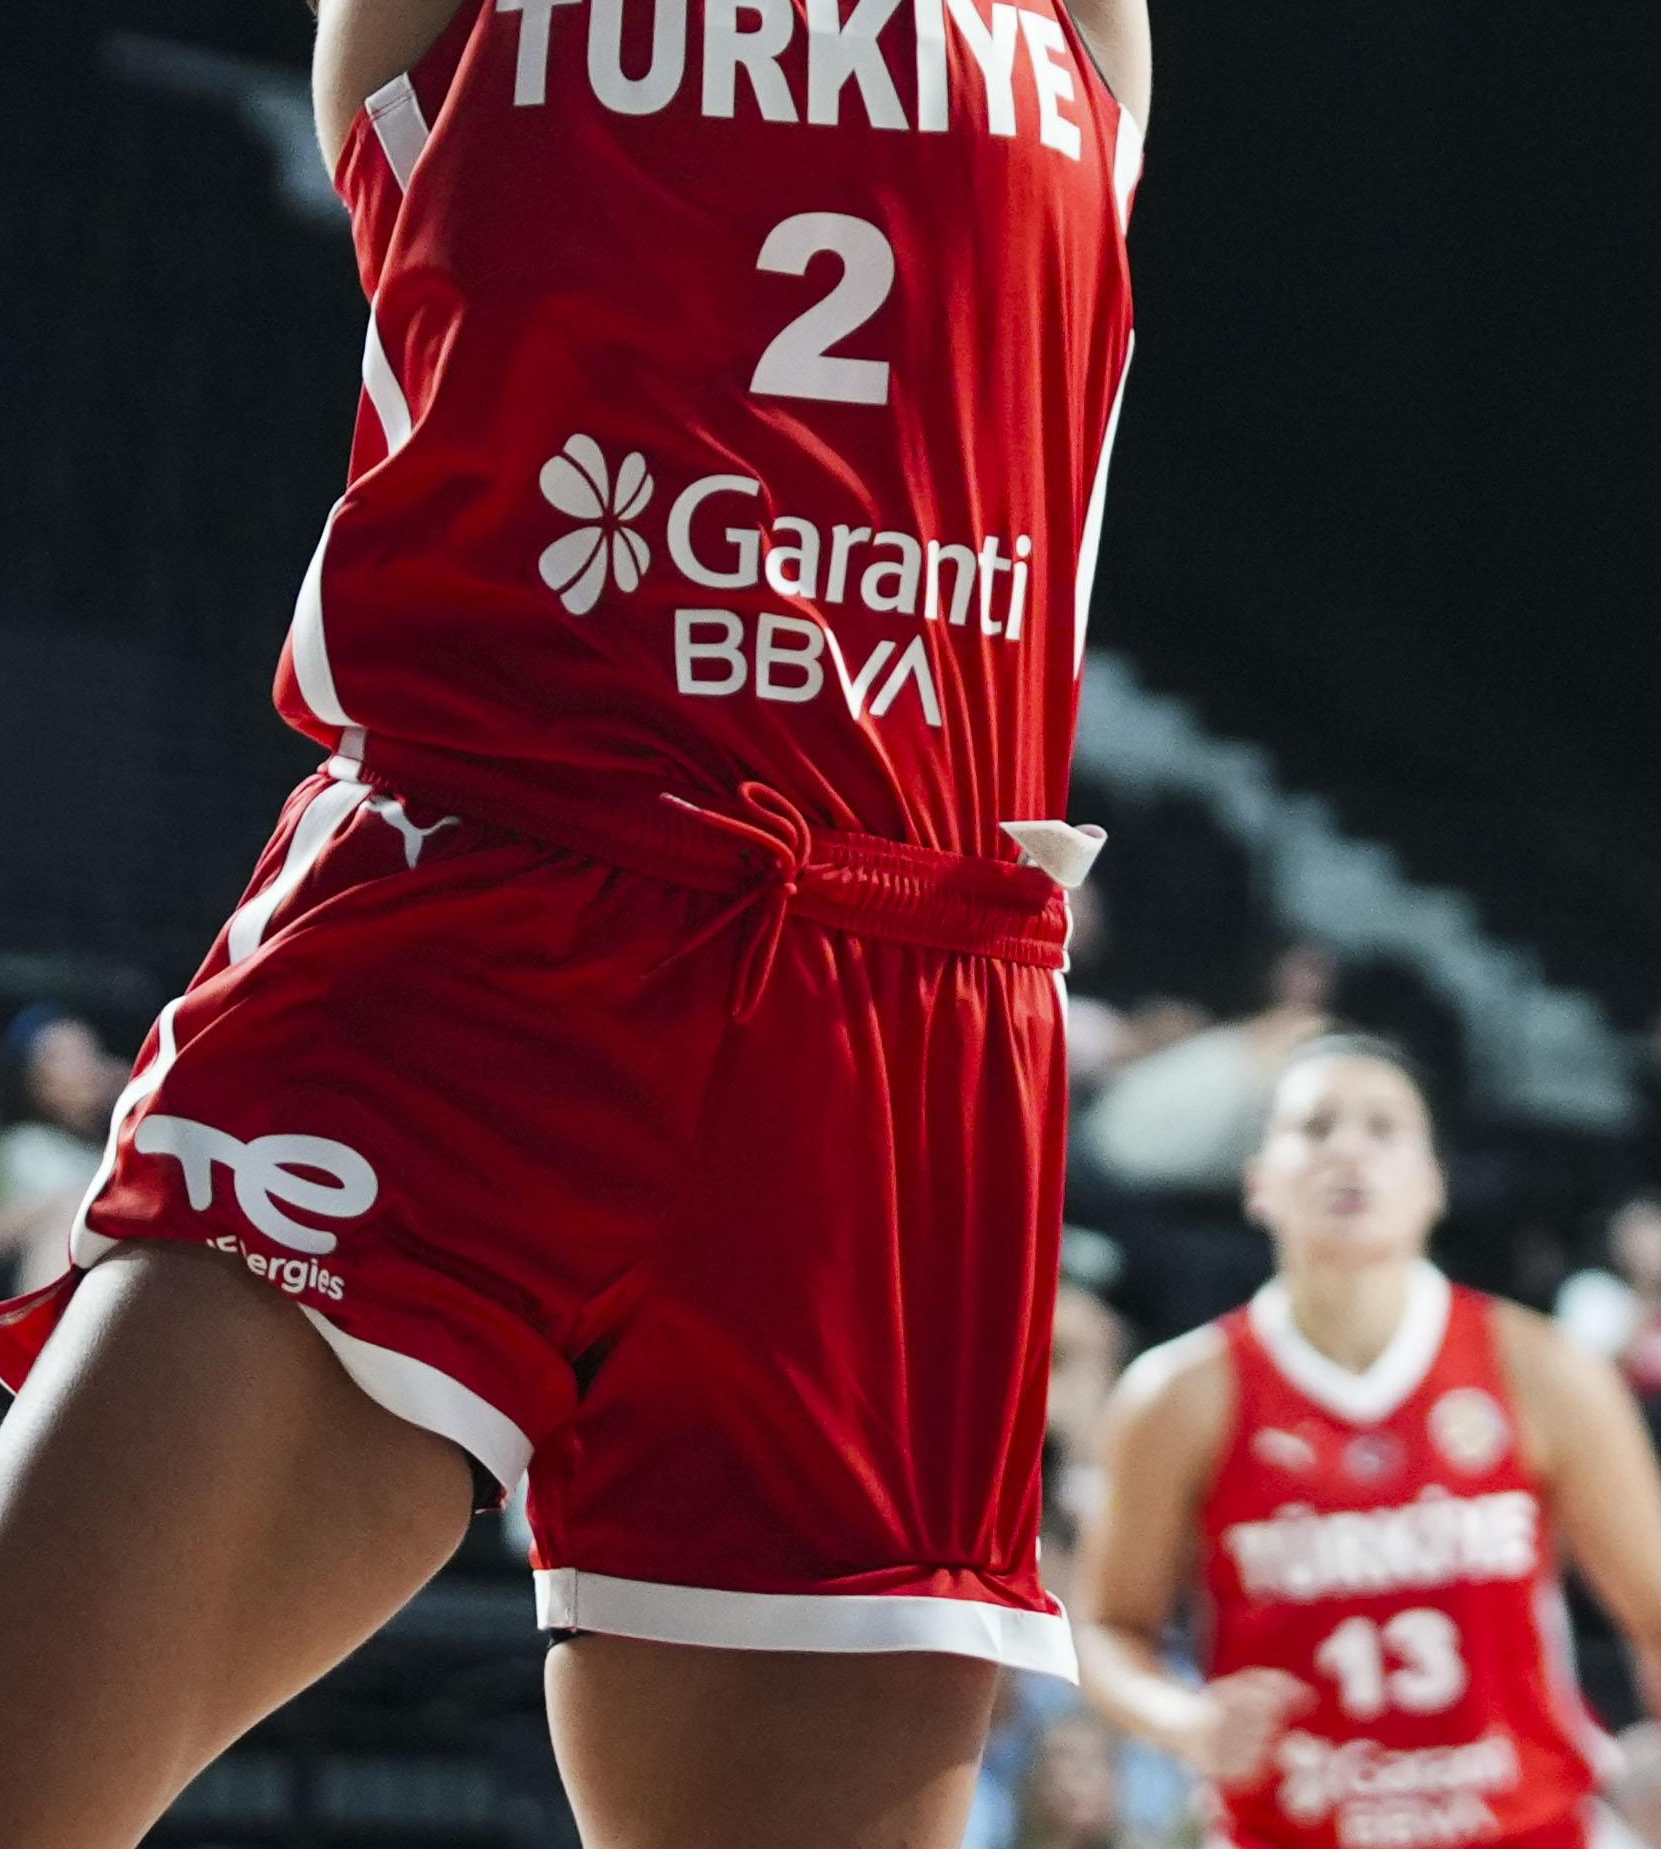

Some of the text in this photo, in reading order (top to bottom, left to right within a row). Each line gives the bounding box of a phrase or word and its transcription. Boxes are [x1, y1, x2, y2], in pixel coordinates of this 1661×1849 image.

[749, 211, 896, 406] 2
[666, 474, 1032, 642] Garanti
[673, 608, 942, 728] BBVA
[1314, 1606, 1467, 1723] 13
